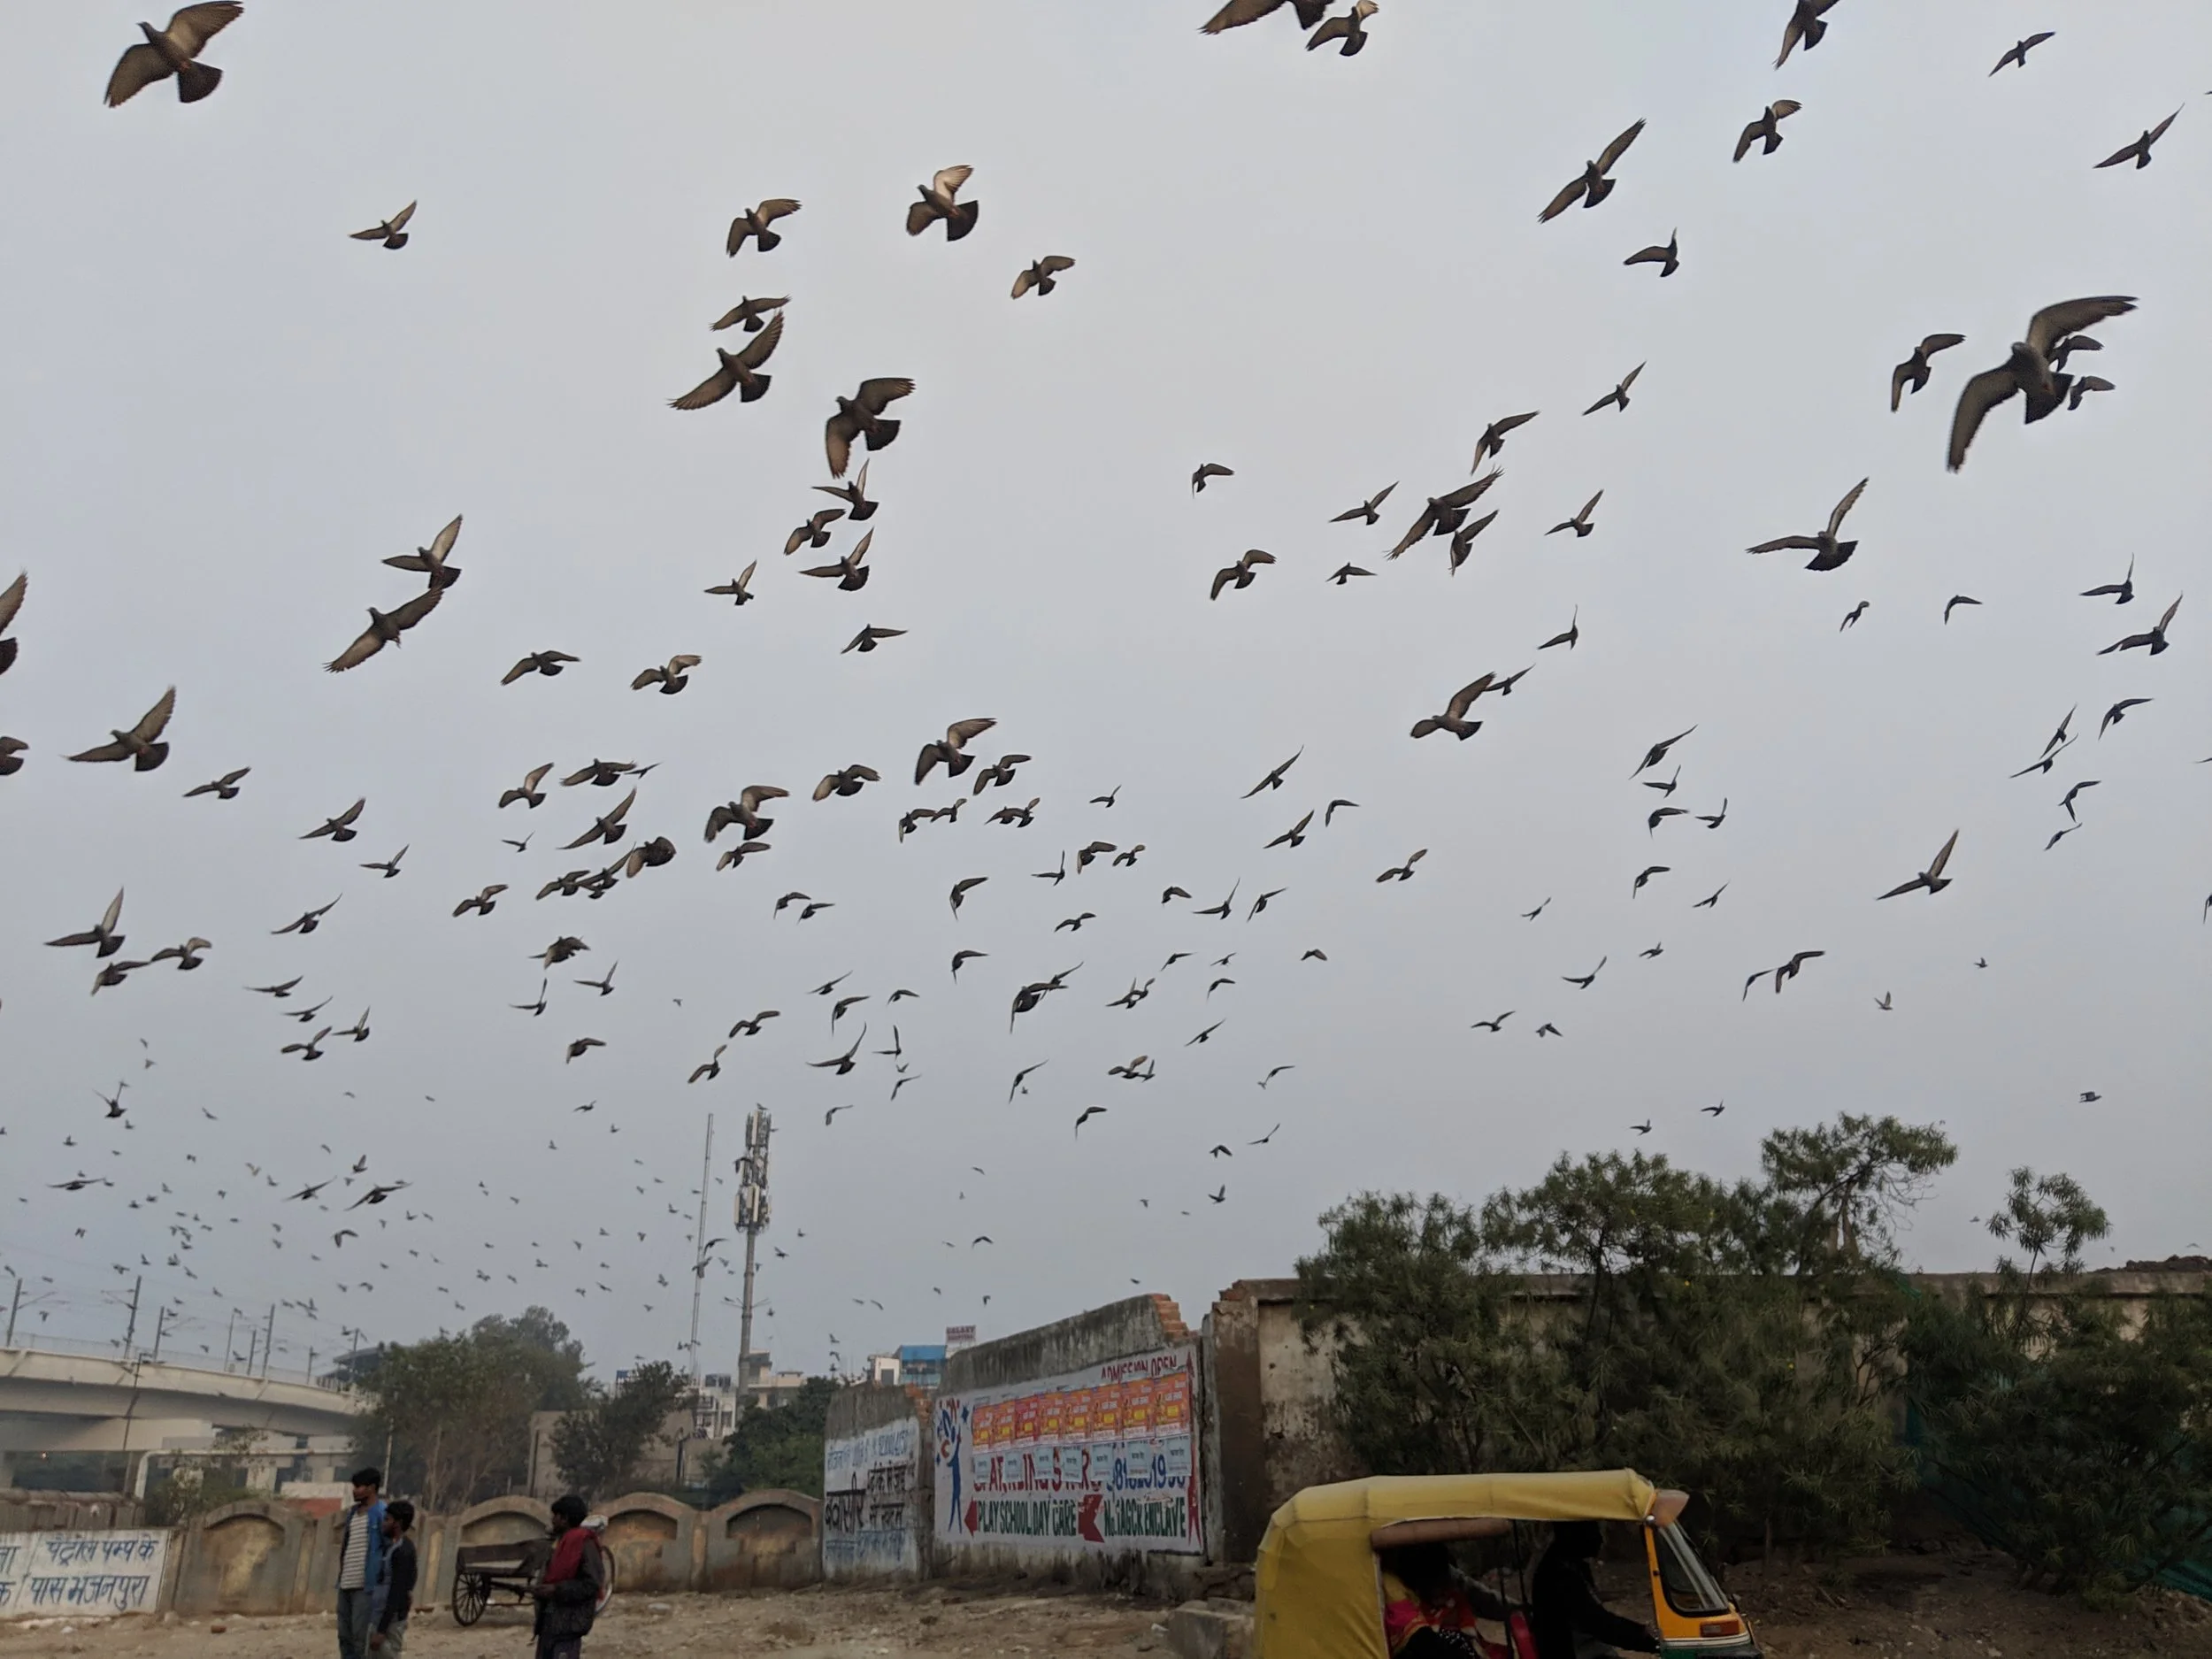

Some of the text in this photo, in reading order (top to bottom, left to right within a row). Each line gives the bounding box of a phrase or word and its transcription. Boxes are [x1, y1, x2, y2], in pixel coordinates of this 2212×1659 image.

[978, 1501, 999, 1532] PLAY
[1033, 1498, 1051, 1536] DAY
[1052, 1499, 1076, 1537] CARE
[138, 1532, 159, 1563] के
[31, 1577, 68, 1606] पास
